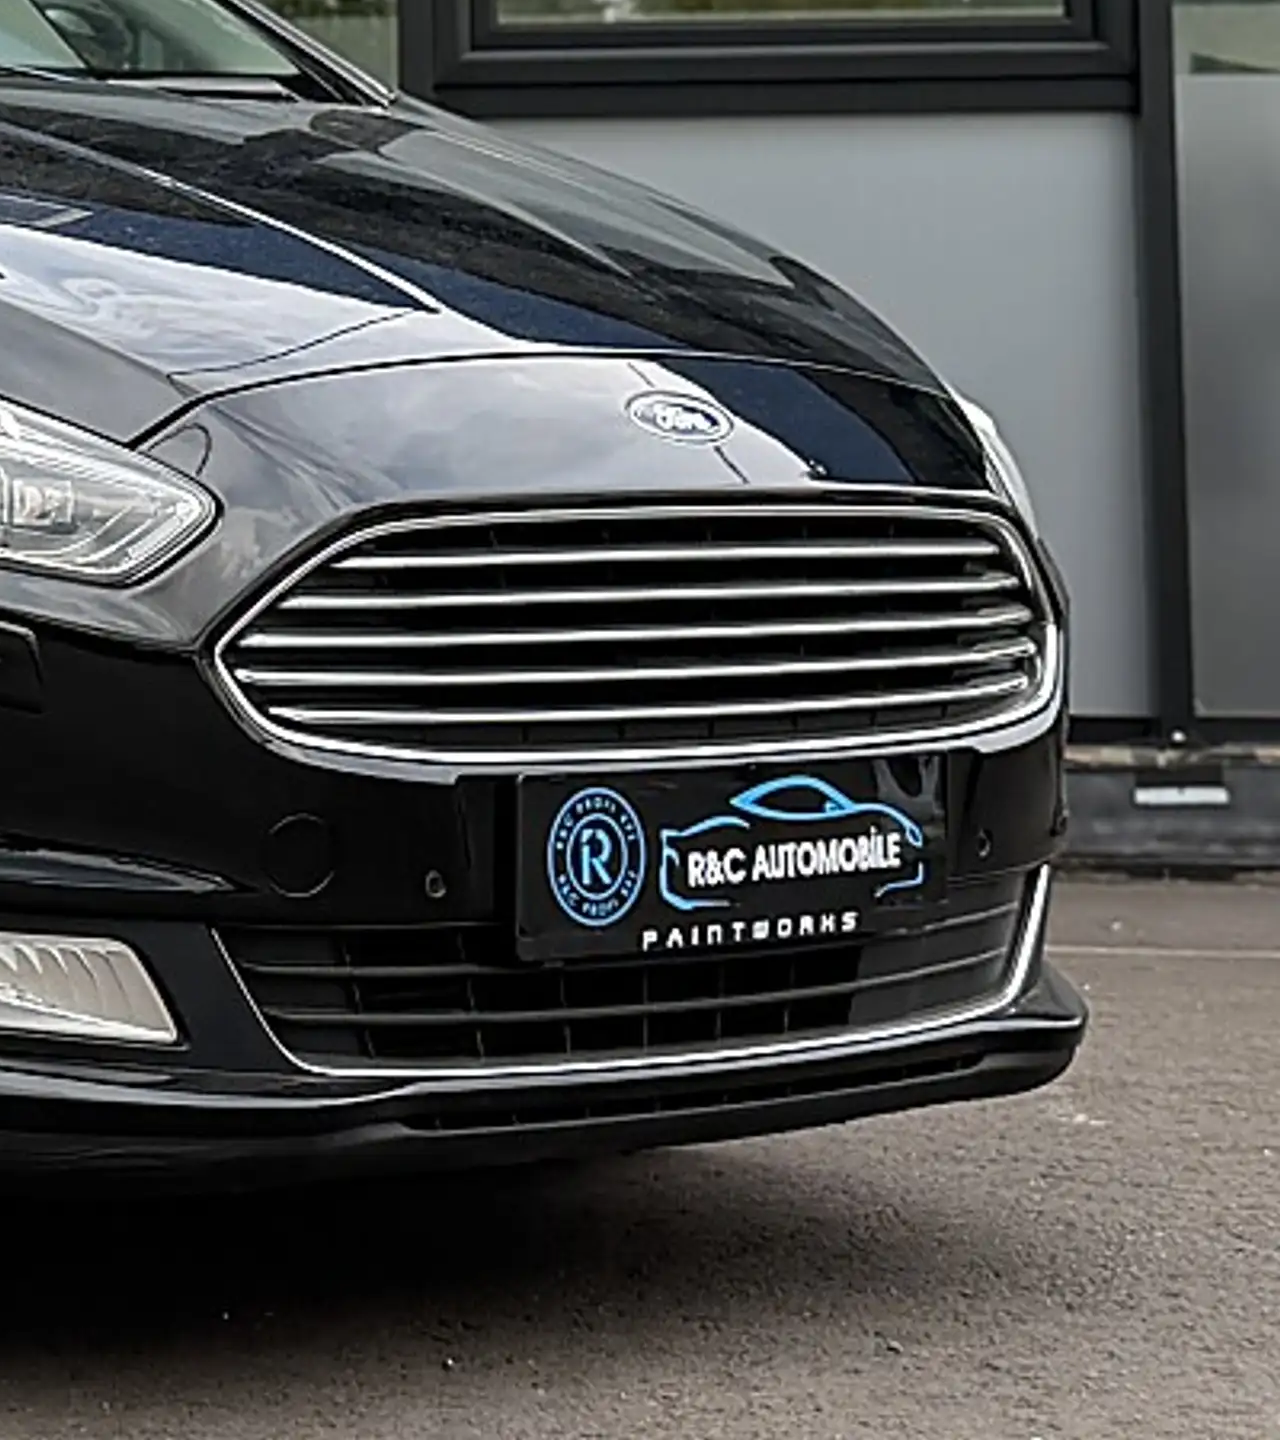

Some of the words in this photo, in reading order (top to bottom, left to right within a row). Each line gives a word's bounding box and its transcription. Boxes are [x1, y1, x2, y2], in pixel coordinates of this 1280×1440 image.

[581, 827, 613, 886] R
[687, 846, 748, 888] R&C
[642, 911, 859, 952] PAINTWORKS
